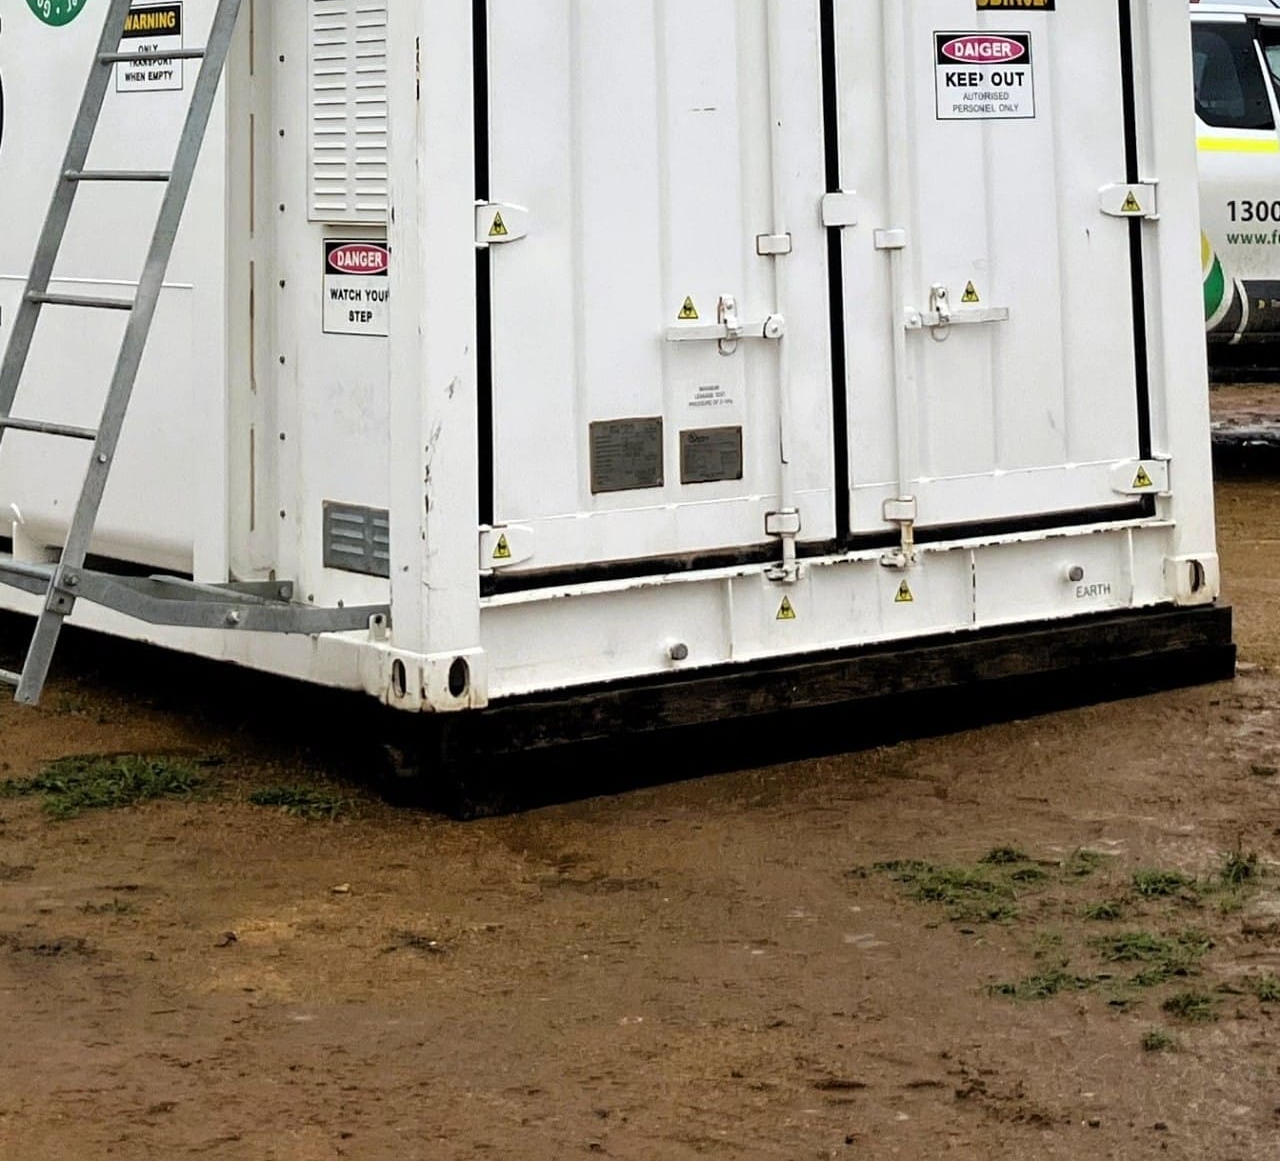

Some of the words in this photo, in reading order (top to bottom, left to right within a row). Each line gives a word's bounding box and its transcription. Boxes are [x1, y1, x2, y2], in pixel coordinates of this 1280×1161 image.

[124, 11, 176, 31] WARNING
[125, 71, 146, 82] WHEN
[148, 69, 173, 81] EMPTY
[991, 71, 1025, 87] OUT
[999, 102, 1019, 112] ONLY
[336, 250, 384, 268] DANGER
[330, 288, 362, 301] WATCH
[348, 310, 373, 323] STEP
[1076, 583, 1111, 598] EARTH
